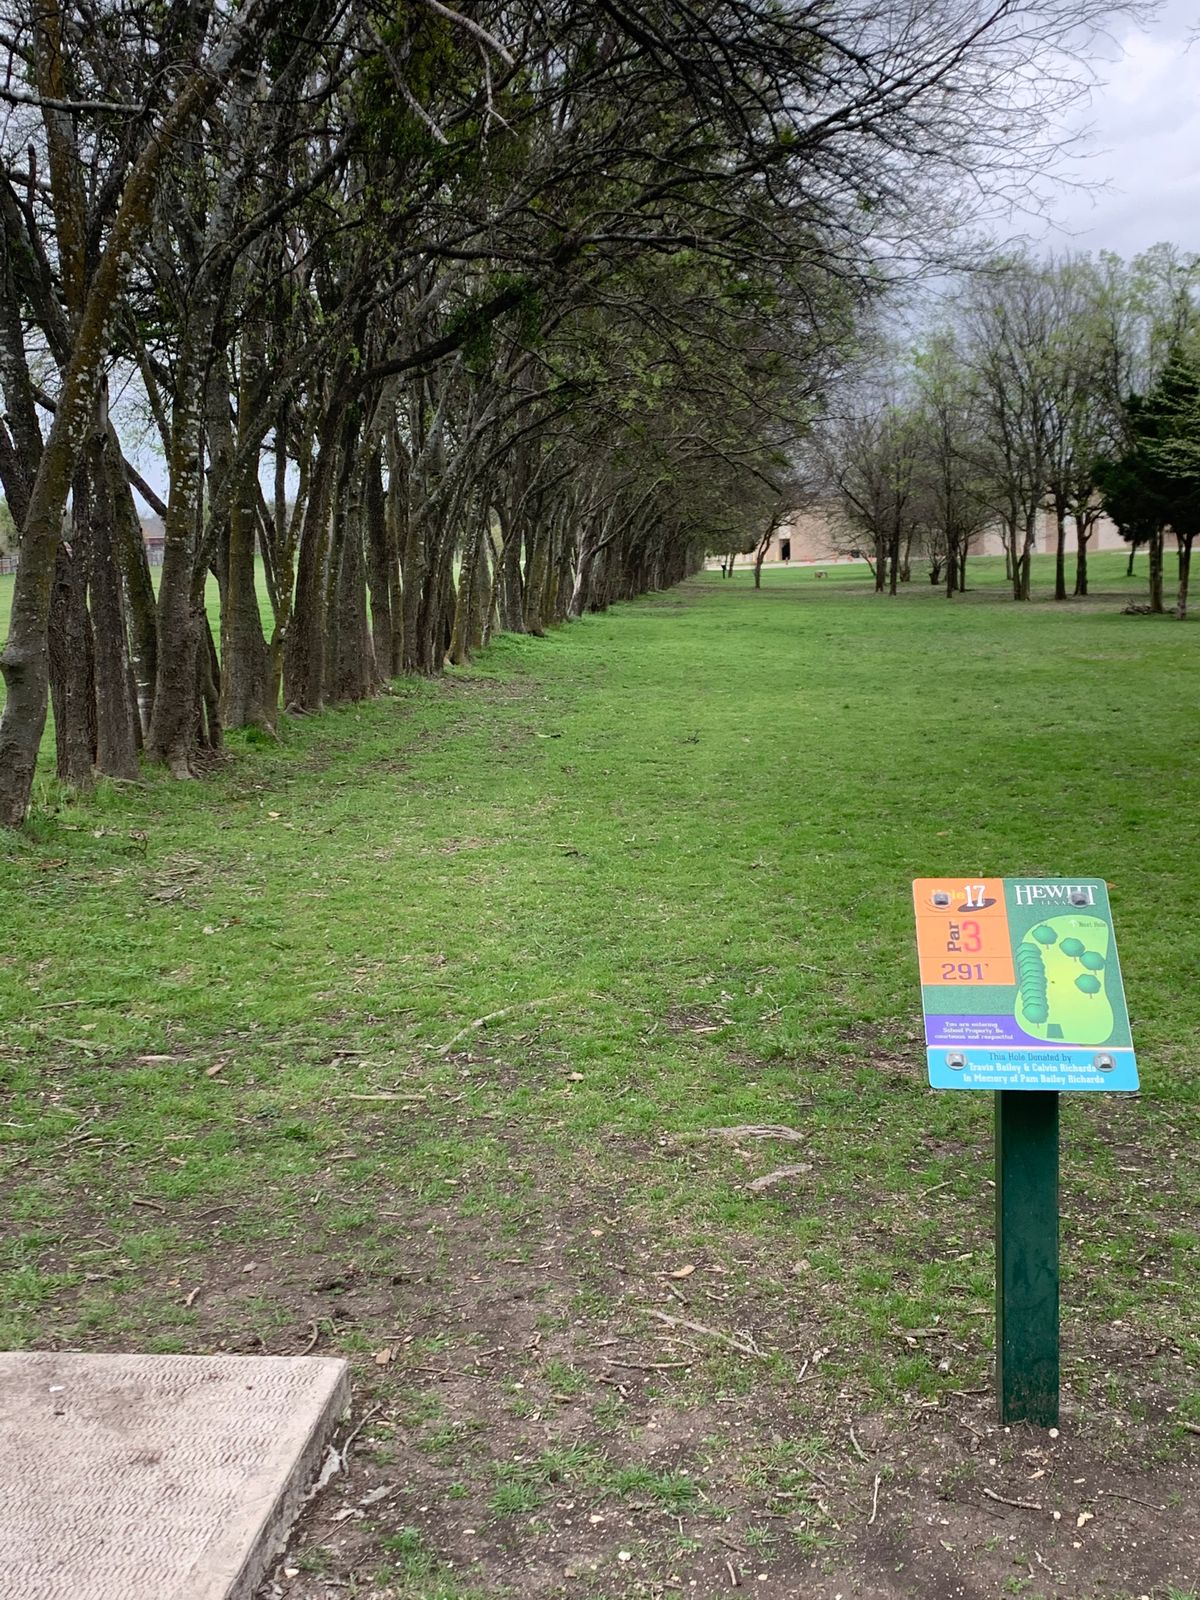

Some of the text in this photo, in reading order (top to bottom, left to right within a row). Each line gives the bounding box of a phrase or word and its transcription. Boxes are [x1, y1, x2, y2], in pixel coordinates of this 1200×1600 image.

[932, 885, 986, 907] le 17
[947, 921, 982, 952] Par 3
[989, 1052, 1072, 1063] This Hole Donated by
[969, 1062, 1096, 1073] Travis Bailey & Calvin Richards
[963, 1073, 1105, 1085] In Memory of Pam Bailey Richards
